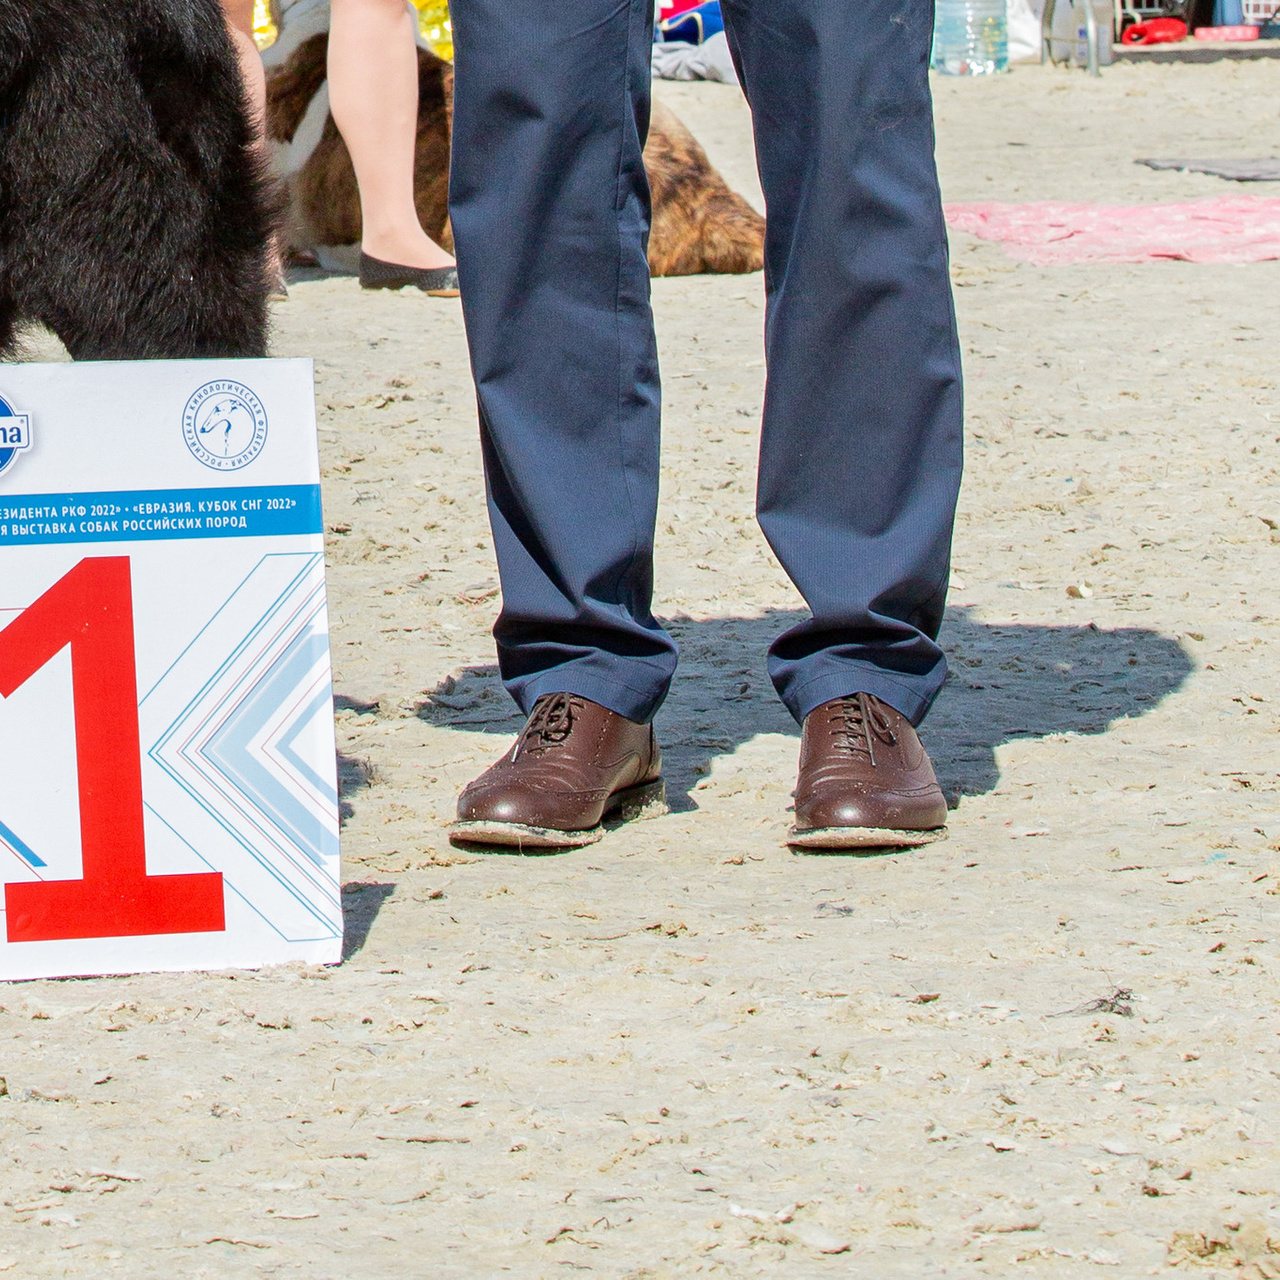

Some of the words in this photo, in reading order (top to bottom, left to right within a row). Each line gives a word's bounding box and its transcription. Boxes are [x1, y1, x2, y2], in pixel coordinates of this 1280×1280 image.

[189, 383, 262, 415] КИНОЛОГИЧЕСКАЯ
[185, 415, 222, 468] РОССИЙСКАЯ
[62, 504, 86, 518] РКФ
[90, 504, 121, 516] 2022»
[132, 501, 195, 515] «ЕВРАЗИЯ.
[198, 500, 237, 513] КУБОК
[241, 499, 263, 511] СНГ
[266, 497, 297, 510] 2022»
[12, 521, 76, 536] ВЫСТАВКА
[79, 519, 119, 533] СОБАК
[122, 517, 203, 532] РОССИЙСКИХ
[206, 515, 248, 529] ПОРОД
